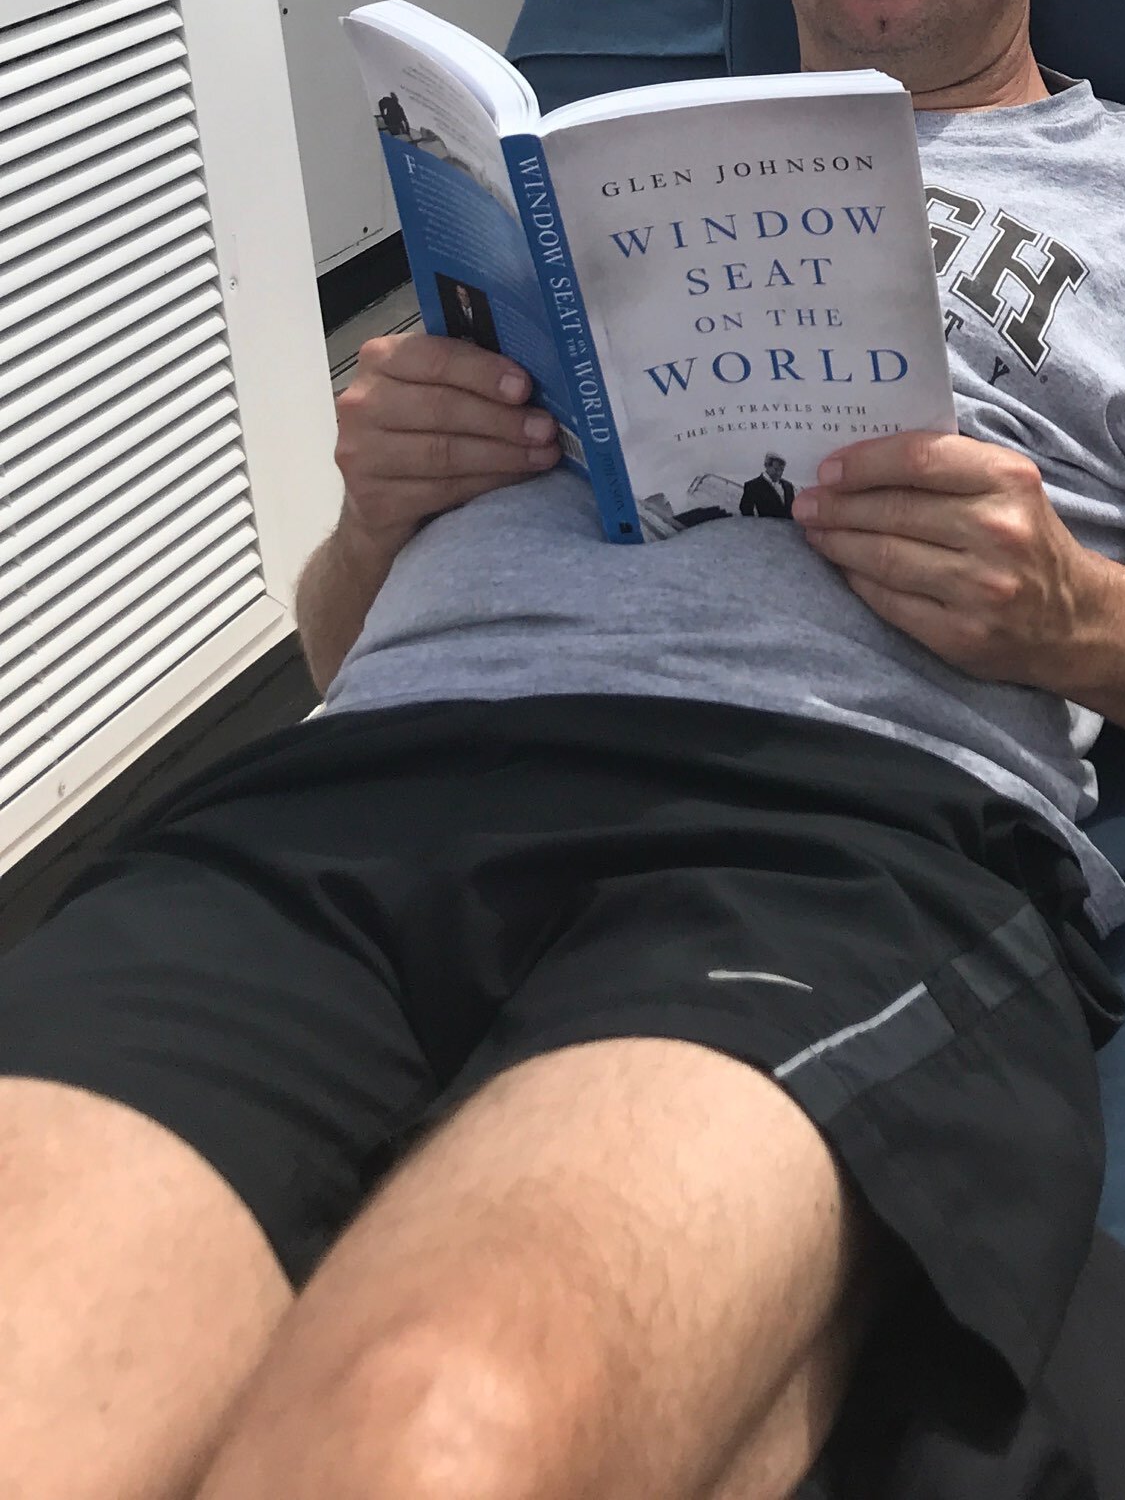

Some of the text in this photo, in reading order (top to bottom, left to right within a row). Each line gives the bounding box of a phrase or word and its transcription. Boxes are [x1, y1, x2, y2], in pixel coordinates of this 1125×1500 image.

[601, 155, 874, 198] GLEN JOHNSON
[518, 155, 567, 268] WINDOW
[550, 276, 584, 334] SEAT
[609, 205, 887, 259] WINDOW
[685, 257, 833, 296] SEAT
[694, 308, 843, 334] ON THE
[643, 348, 909, 397] WORLD
[573, 360, 611, 444] WORLD
[704, 403, 867, 418] MY TRAVELS WITH
[674, 419, 904, 443] THE SECRETARY OF STATE
